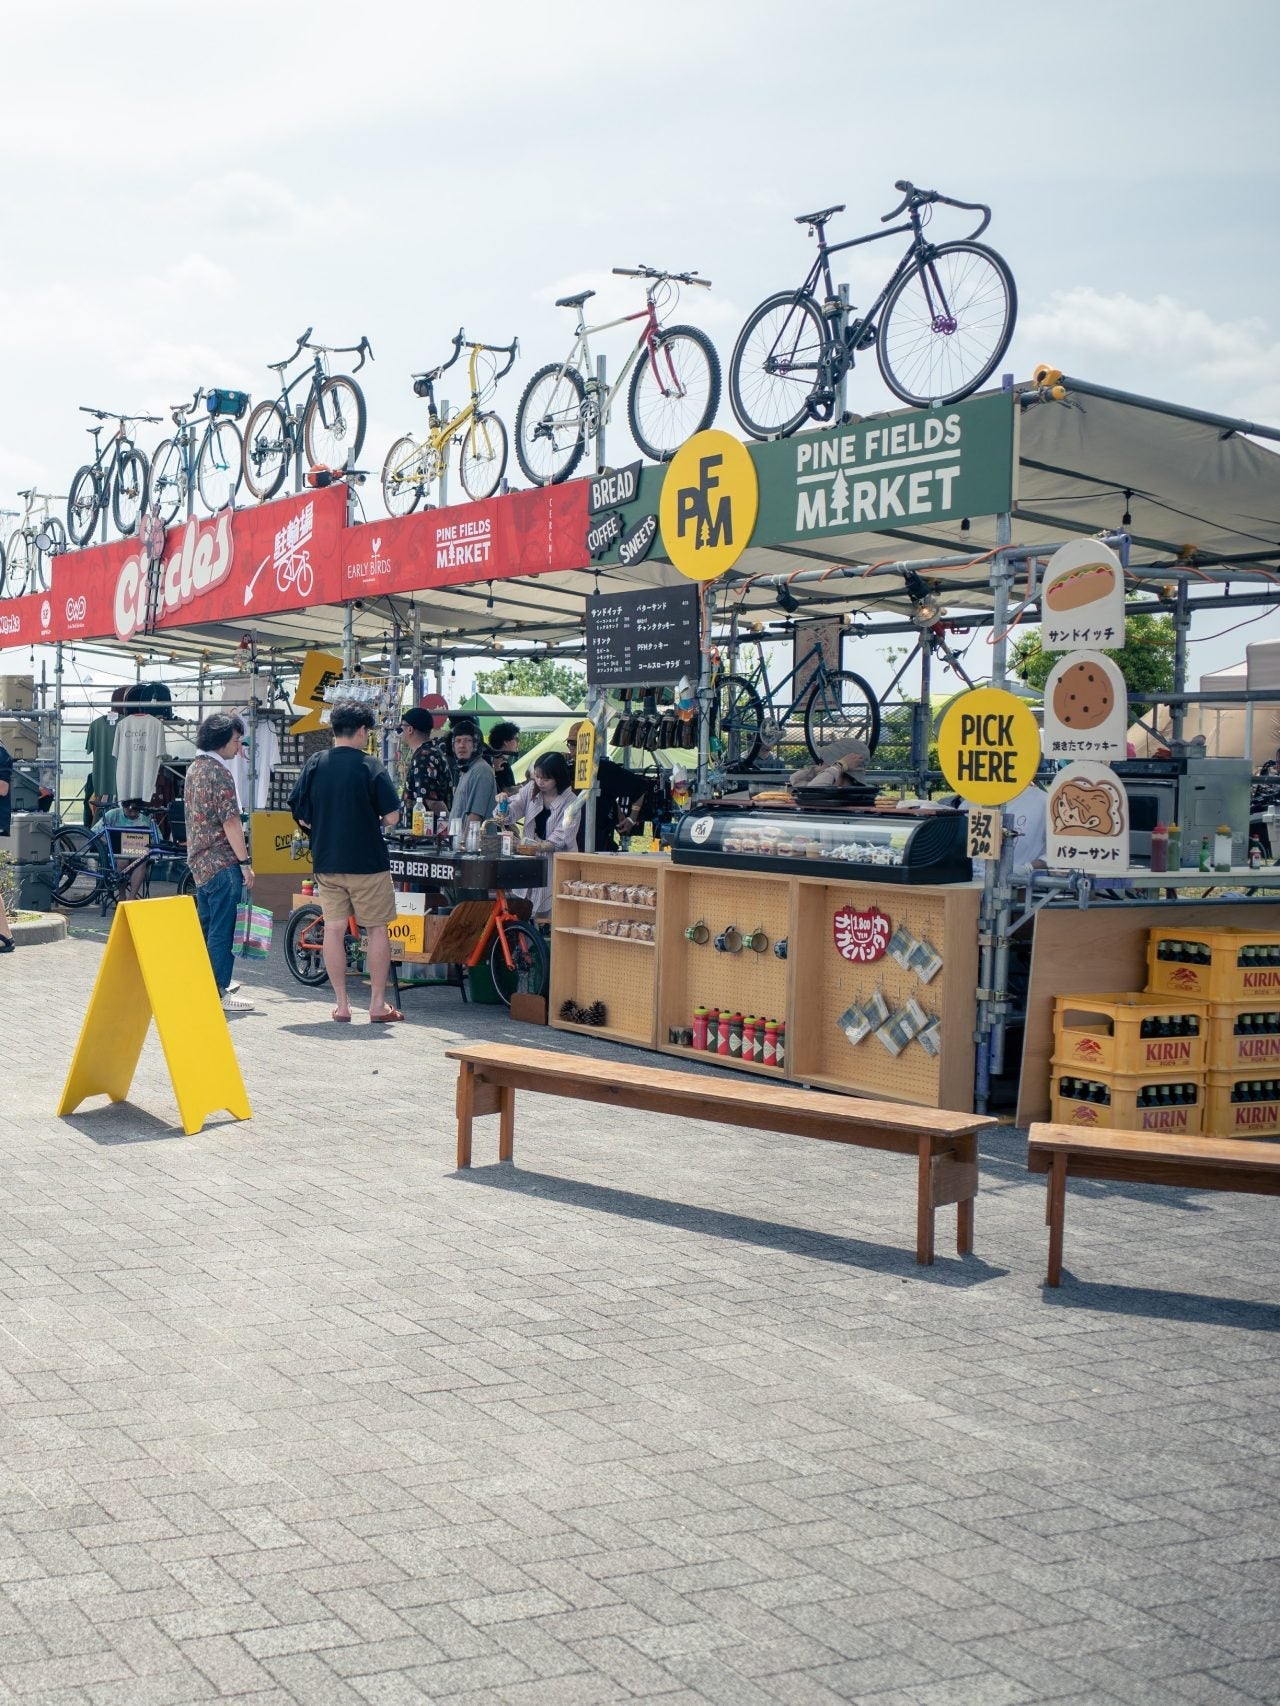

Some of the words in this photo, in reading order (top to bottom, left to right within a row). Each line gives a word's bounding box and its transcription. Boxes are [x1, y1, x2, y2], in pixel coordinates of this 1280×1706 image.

[797, 434, 856, 473] PINE
[865, 413, 961, 460] FIELDS
[592, 470, 634, 510] BREAD
[273, 501, 314, 560] 駐輪場
[436, 525, 457, 542] PINE
[459, 519, 491, 536] FIELDS
[587, 516, 618, 551] COFFEE
[620, 515, 656, 564] SWEETS
[116, 513, 232, 636] Circles
[348, 561, 369, 579] EARLY
[370, 558, 391, 575] BIRDS
[1048, 628, 1115, 643] サンドイッチ
[961, 714, 1014, 747] PICK
[1052, 740, 1119, 752] 焼きたてクッキー
[958, 750, 1018, 783] HERE
[1056, 845, 1120, 860] バターサンド
[389, 860, 405, 875] EER
[406, 861, 429, 877] BEER
[430, 863, 454, 880] BEER
[1243, 971, 1280, 988] KIRIN
[1145, 1041, 1191, 1061] KIRIN
[1238, 1038, 1280, 1058] KIRIN
[1142, 1109, 1188, 1130] KIRIN
[1235, 1105, 1279, 1125] KIRIN
